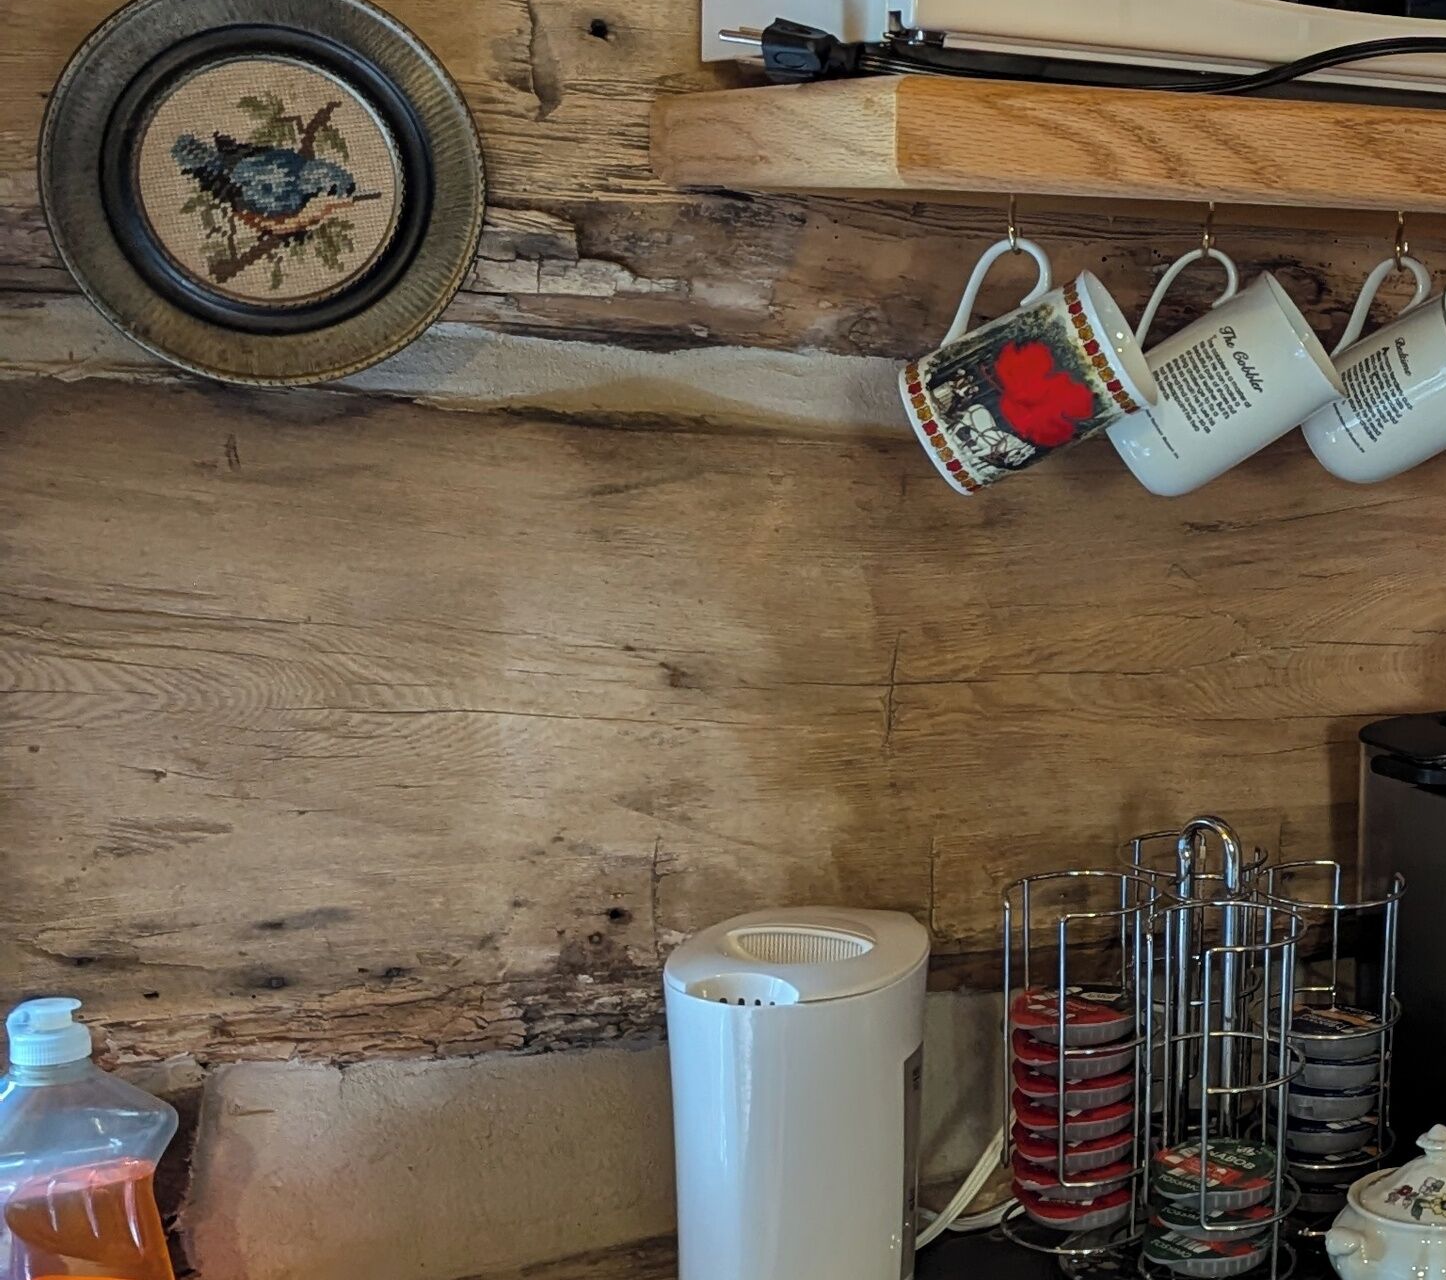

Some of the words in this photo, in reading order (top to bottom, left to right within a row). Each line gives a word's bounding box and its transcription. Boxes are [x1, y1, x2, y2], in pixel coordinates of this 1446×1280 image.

[1219, 325, 1236, 348] The
[1232, 351, 1262, 392] Cobbler
[1394, 336, 1411, 375] Bedtime
[1166, 381, 1187, 412] disappoint
[1186, 367, 1205, 397] challenge
[1203, 368, 1214, 380] pair
[1216, 387, 1229, 404] shoes
[1226, 404, 1237, 414] out
[1215, 371, 1225, 383] can
[1223, 383, 1236, 401] make
[1231, 380, 1246, 401] master
[1209, 1150, 1256, 1170] NABOB
